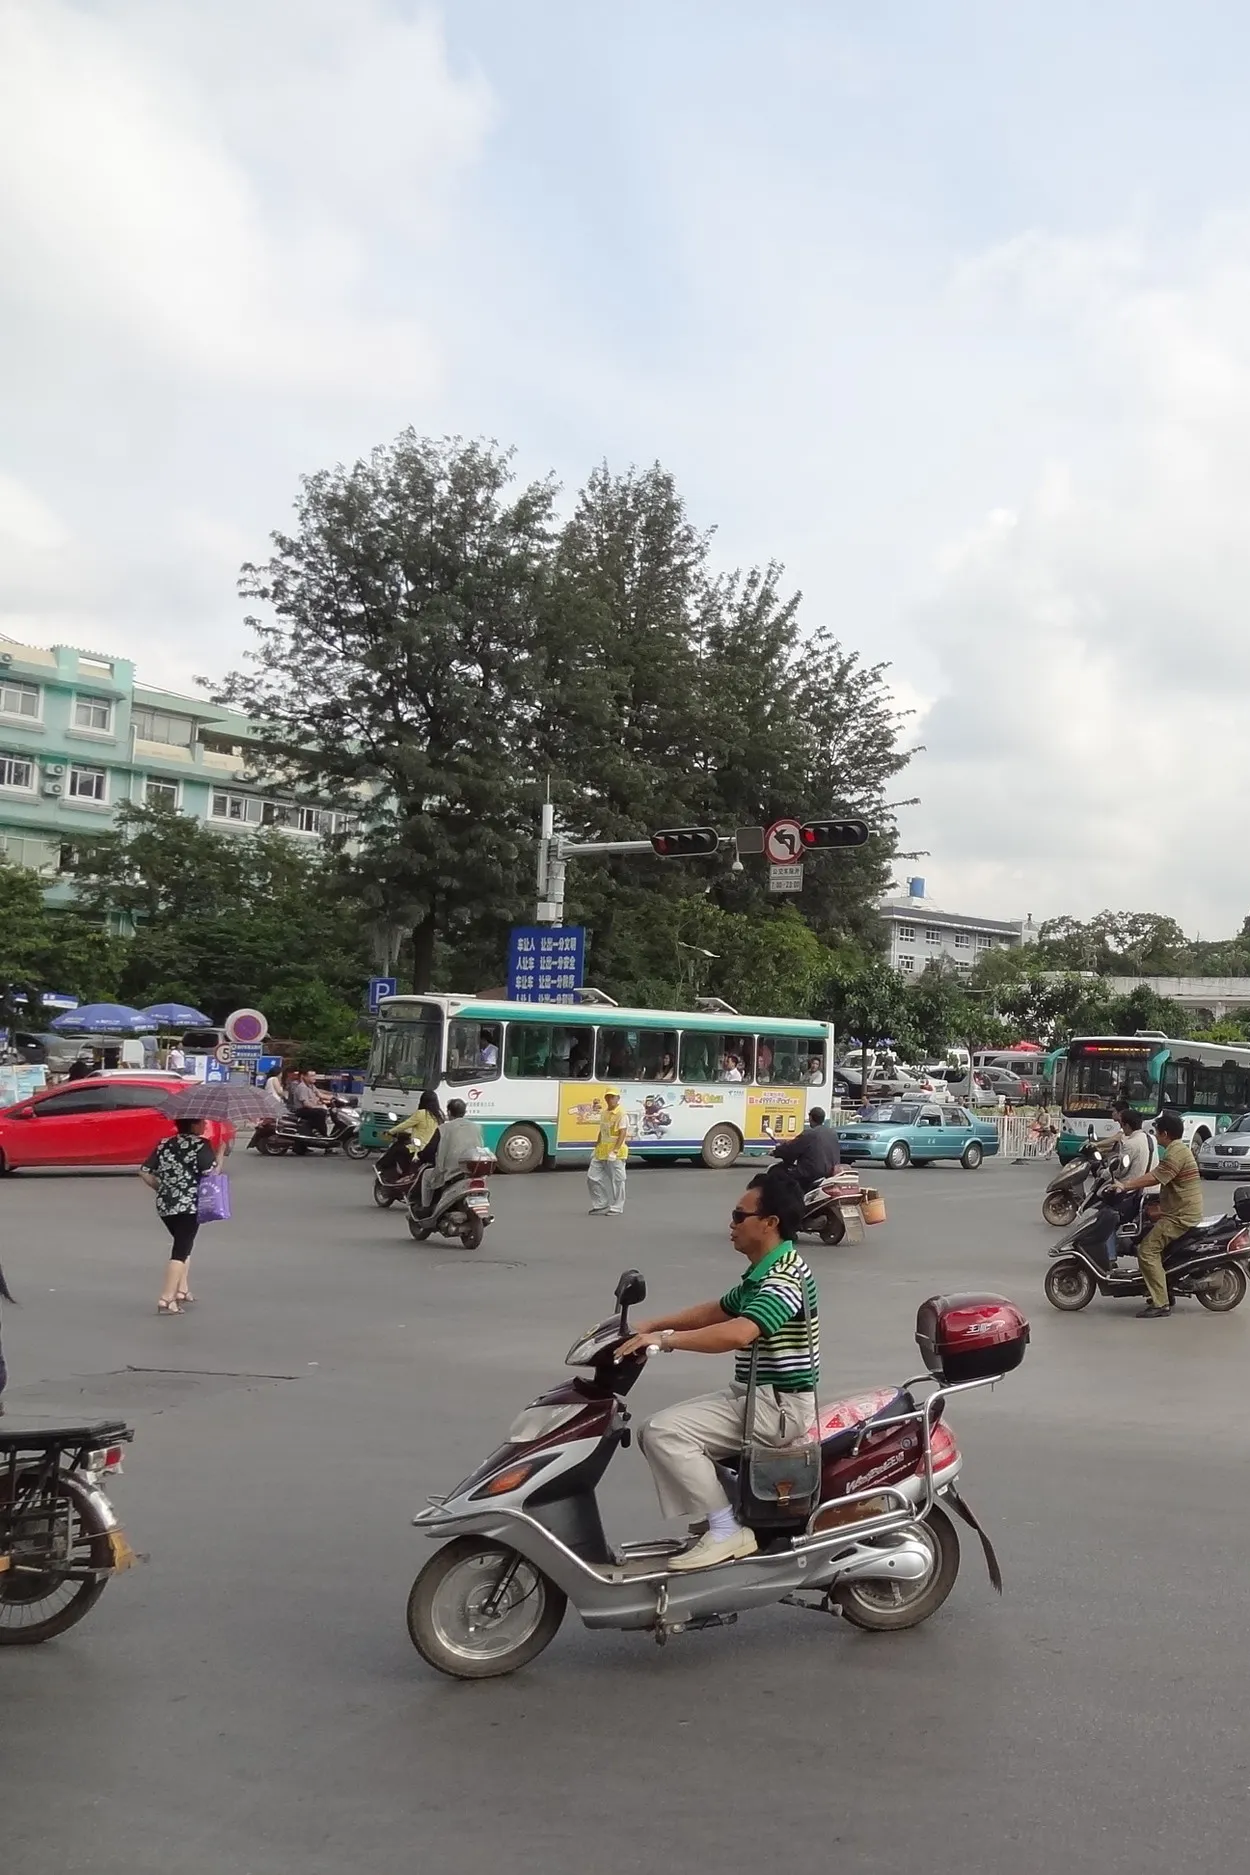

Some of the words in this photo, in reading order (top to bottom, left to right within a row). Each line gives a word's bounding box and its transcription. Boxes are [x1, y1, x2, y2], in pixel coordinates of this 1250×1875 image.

[517, 937, 535, 951] 车让人
[516, 956, 535, 970] 人让车
[515, 974, 534, 989] 车让车
[375, 983, 390, 1002] P
[222, 1048, 229, 1060] 5
